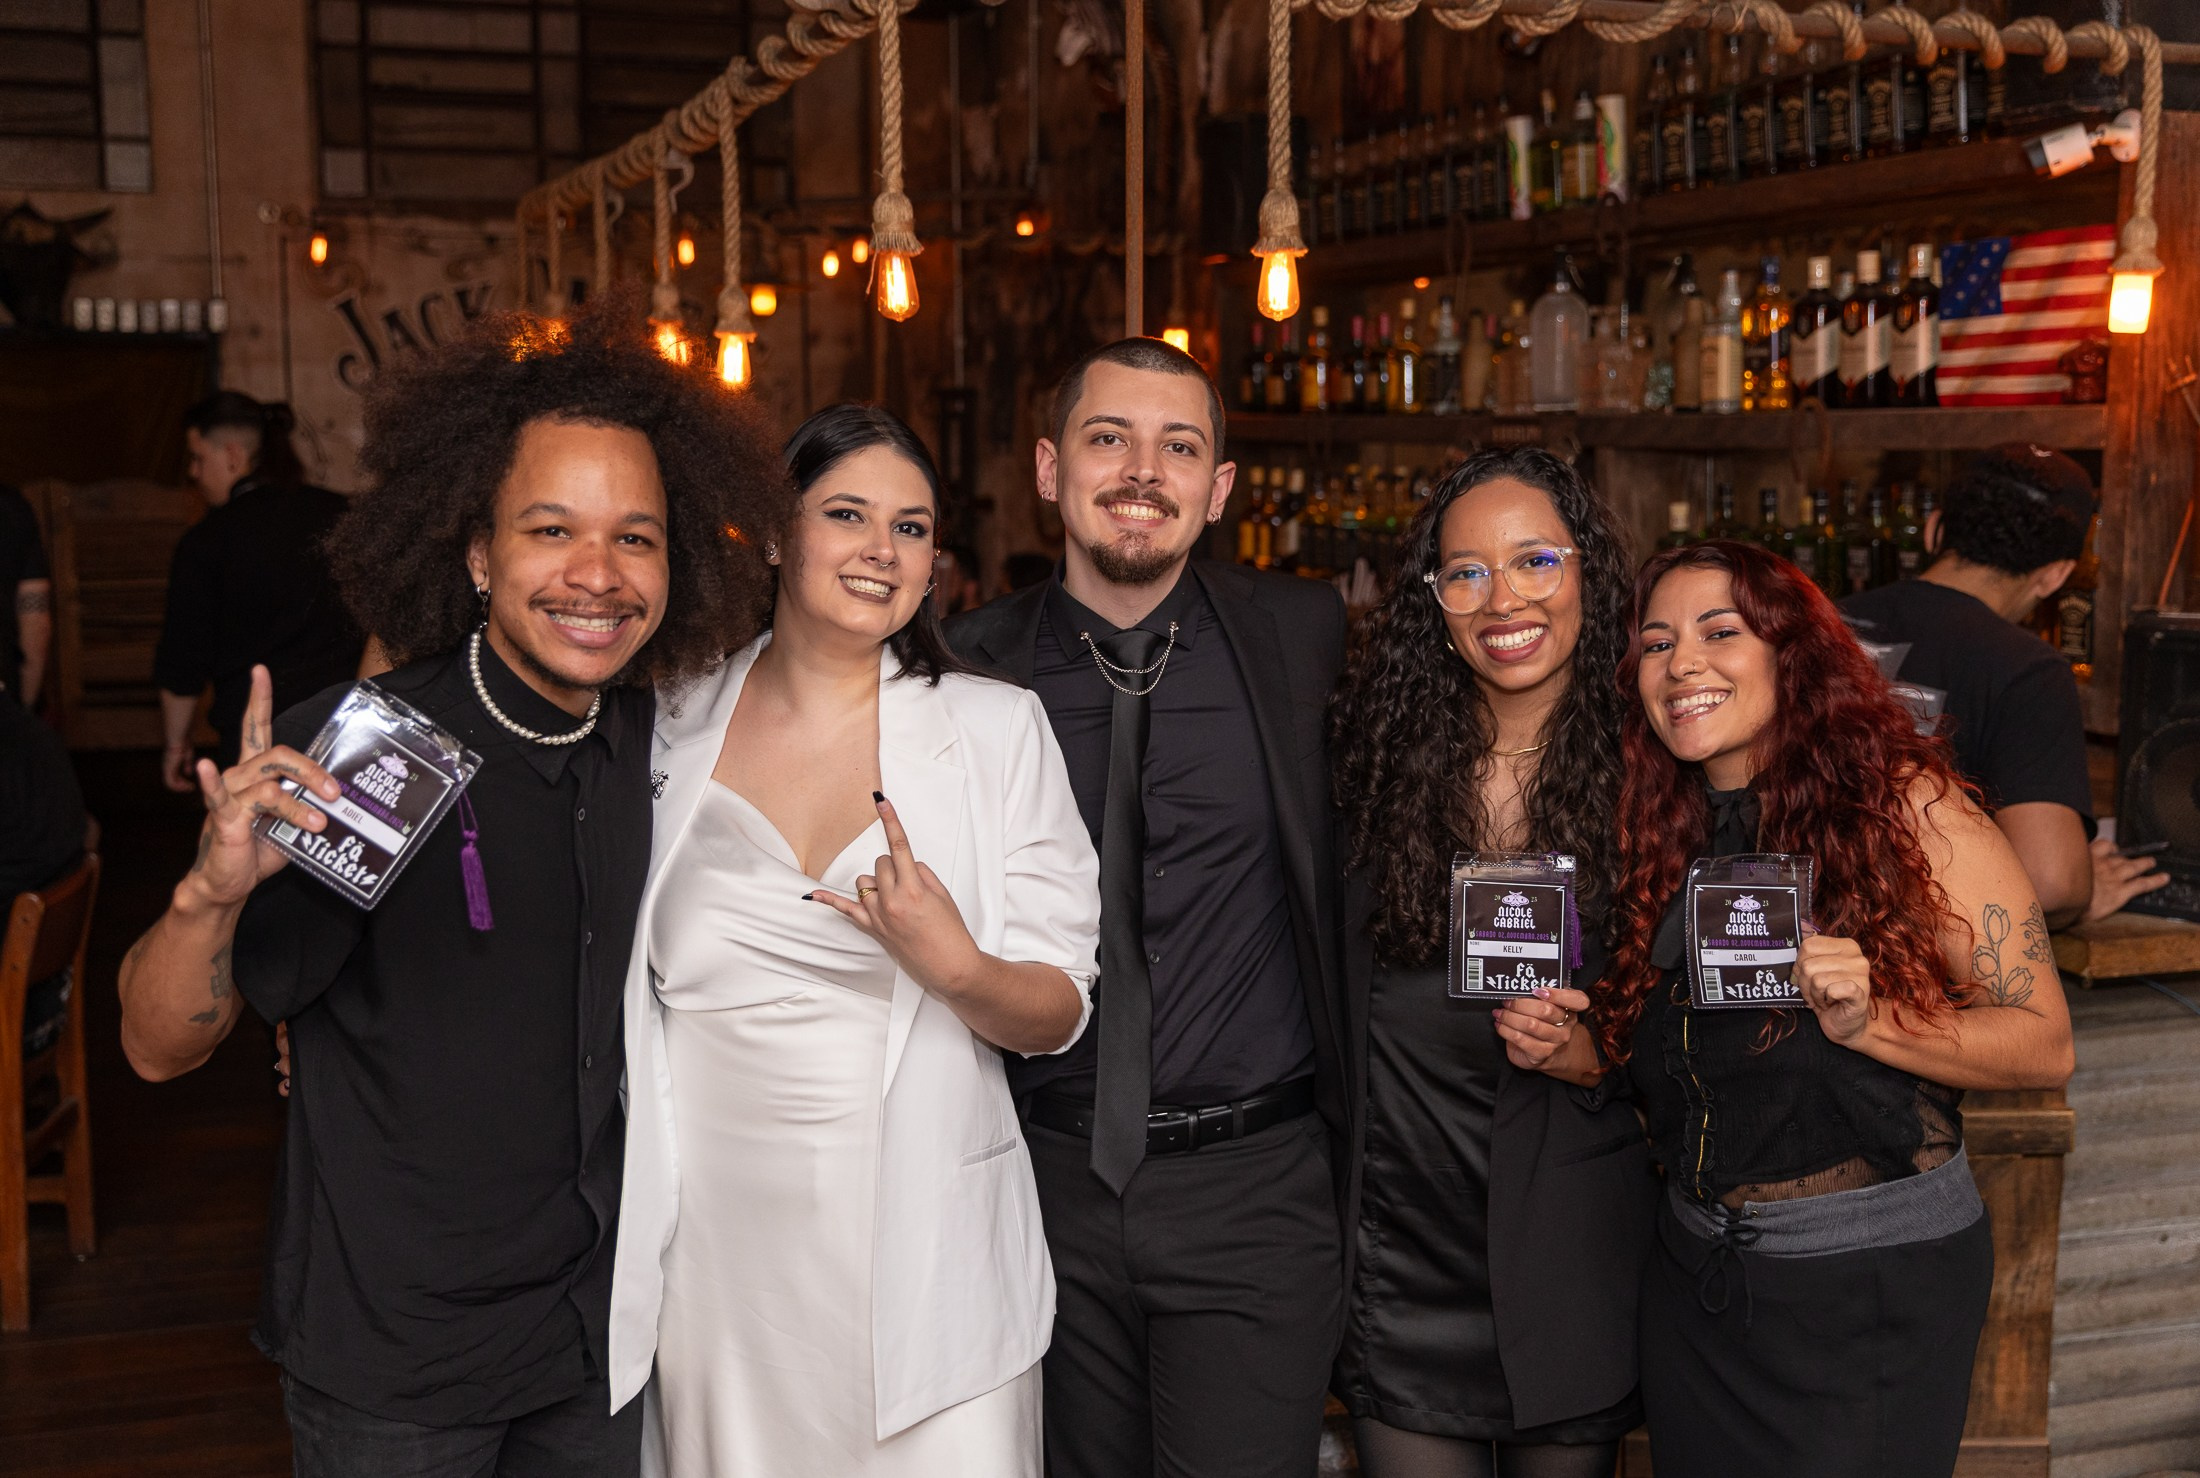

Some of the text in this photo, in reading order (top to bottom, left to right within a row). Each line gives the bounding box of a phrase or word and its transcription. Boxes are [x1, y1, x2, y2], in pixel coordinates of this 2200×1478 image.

[364, 763, 406, 795] NICOLE
[353, 771, 400, 809] GABRIEL
[342, 806, 364, 824] ADIEL
[1498, 906, 1533, 918] NICOLE
[1729, 911, 1765, 924] NICOLE
[1493, 916, 1536, 929] GABRIEL
[1725, 922, 1770, 936] GABRIEL
[1503, 945, 1523, 954] KELLY
[1734, 953, 1758, 962] CAROL
[1734, 980, 1791, 1000] Ticket
